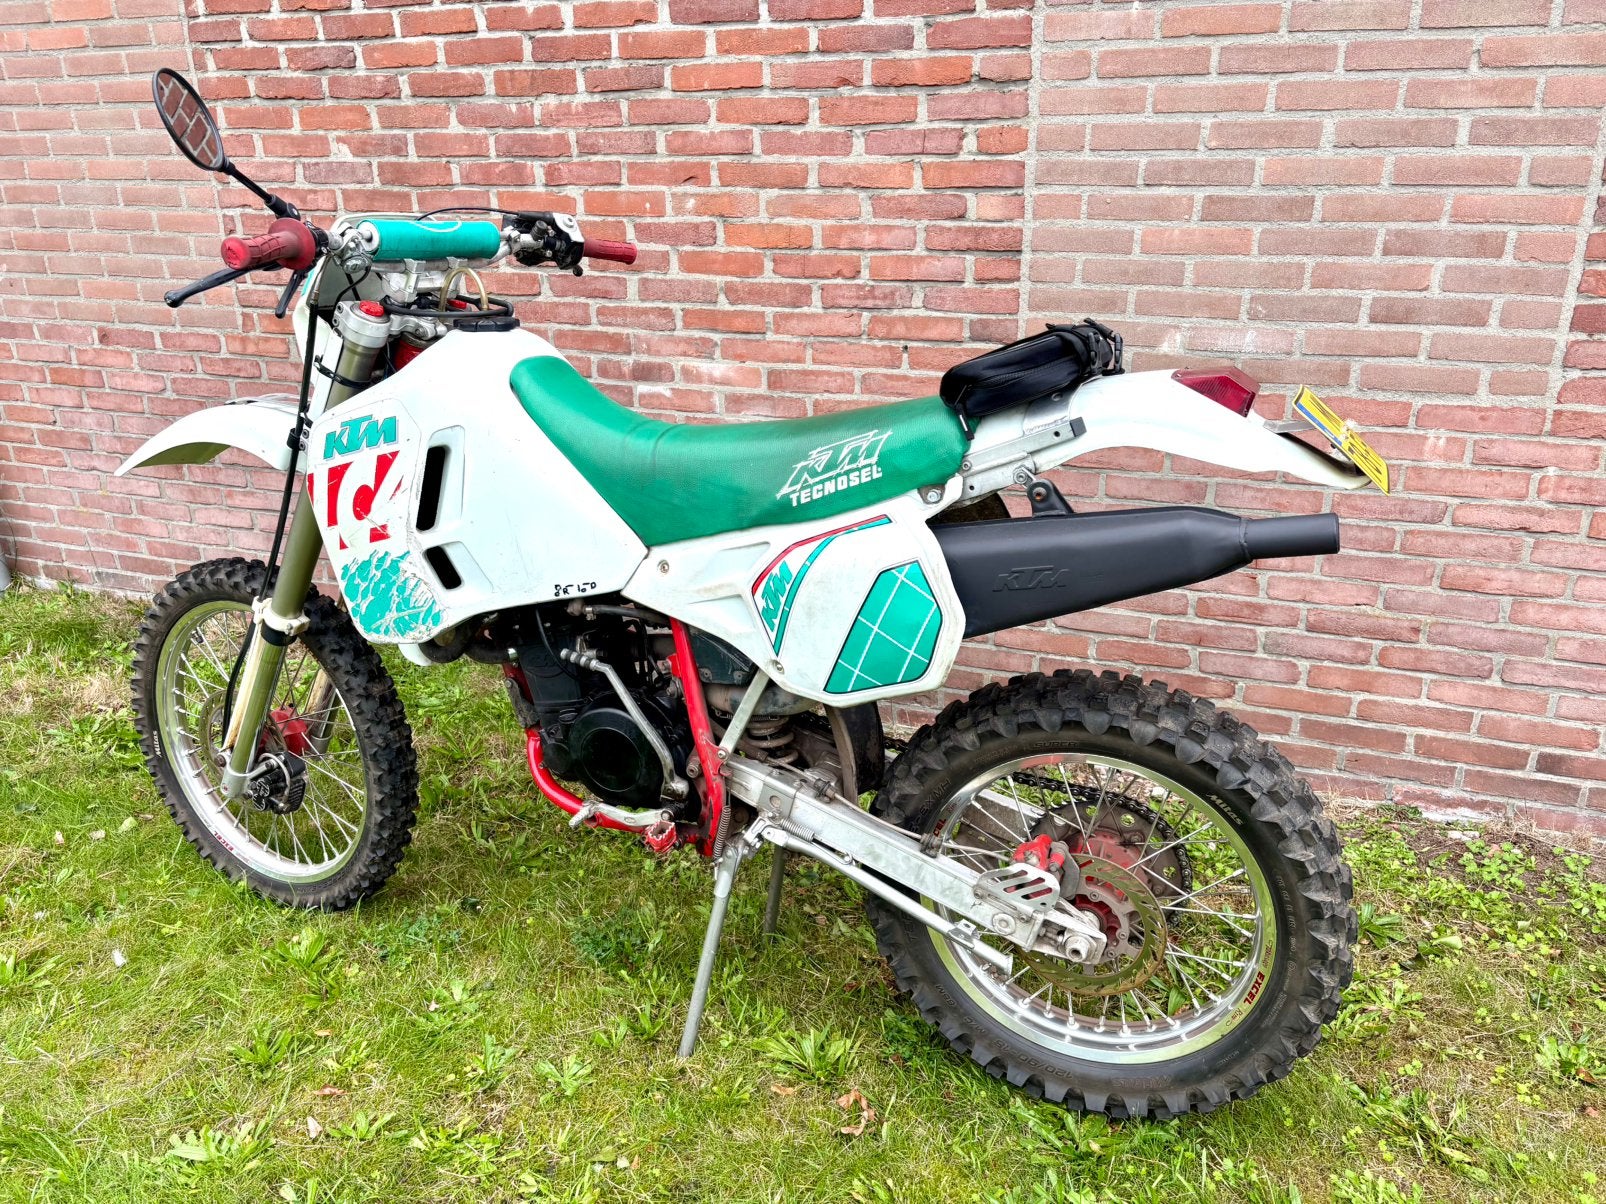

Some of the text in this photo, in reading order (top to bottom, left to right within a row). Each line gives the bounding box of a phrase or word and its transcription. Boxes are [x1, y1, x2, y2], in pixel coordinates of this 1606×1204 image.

[323, 414, 397, 460] KTM
[776, 428, 893, 500] KTM
[789, 465, 883, 507] TECNOSEL
[761, 560, 793, 632] KTM
[992, 565, 1070, 592] KTM
[1206, 793, 1244, 825] Mitas
[214, 831, 235, 852] EXCEL
[1243, 971, 1265, 1005] EXCEL
